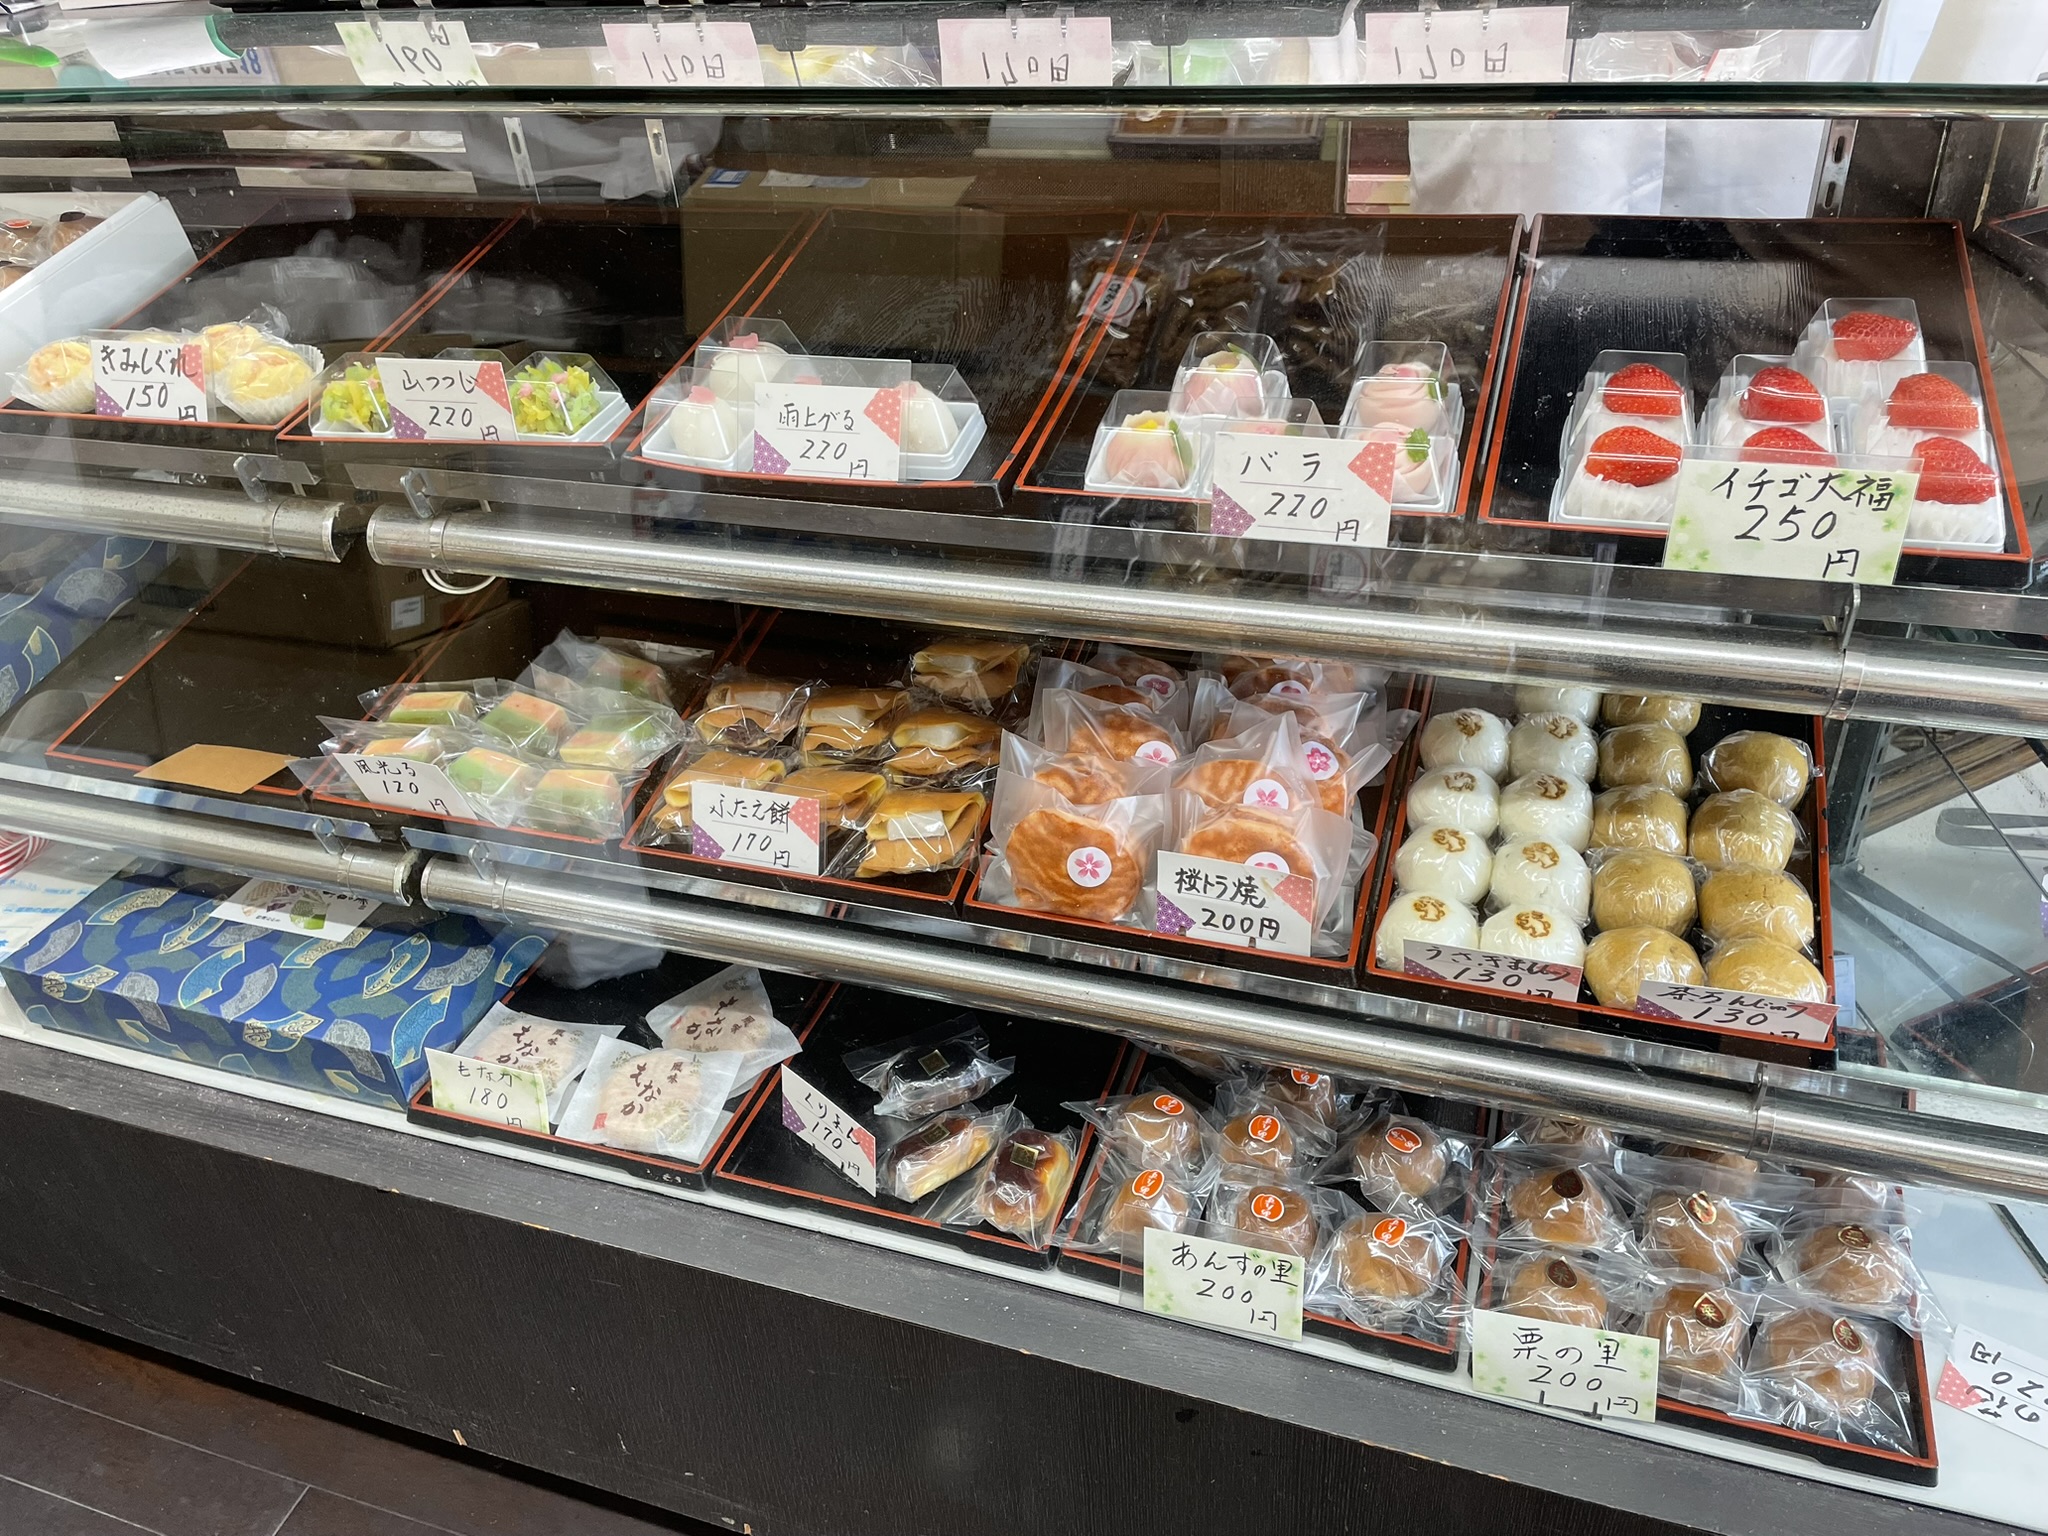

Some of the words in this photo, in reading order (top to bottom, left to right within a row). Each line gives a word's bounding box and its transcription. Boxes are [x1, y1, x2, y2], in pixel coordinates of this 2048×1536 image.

[99, 344, 198, 378] きみしぐれ
[402, 369, 479, 394] 山つつじ
[125, 382, 169, 411] 150
[428, 405, 473, 428] 220
[778, 402, 855, 432] 雨上がる
[799, 438, 848, 461] 220
[849, 458, 869, 478] 円
[1239, 450, 1321, 483] バラ
[1710, 467, 1896, 512] イチゴ大福
[1263, 491, 1329, 520] 220
[1335, 518, 1360, 543] 円
[1733, 504, 1837, 542] 250
[1822, 548, 1861, 579] 円
[382, 780, 419, 795] 120
[708, 793, 791, 834] ふたえ餅
[731, 832, 773, 852] 170
[773, 850, 791, 869] 円
[1174, 867, 1267, 909] 桜トラ焼
[1201, 908, 1281, 941] 200円
[1452, 967, 1524, 988] 130
[1692, 1006, 1769, 1026] 130
[457, 1060, 523, 1088] もなか
[468, 1086, 508, 1110] 180
[811, 1121, 843, 1150] 170
[1171, 1240, 1299, 1288] あんずの里
[1195, 1278, 1253, 1304] 200
[1249, 1308, 1277, 1332] 円
[1512, 1326, 1628, 1373] 栗の里
[1528, 1364, 1603, 1391] 200
[1990, 1371, 2048, 1406] 20
[1607, 1396, 1639, 1415] 円
